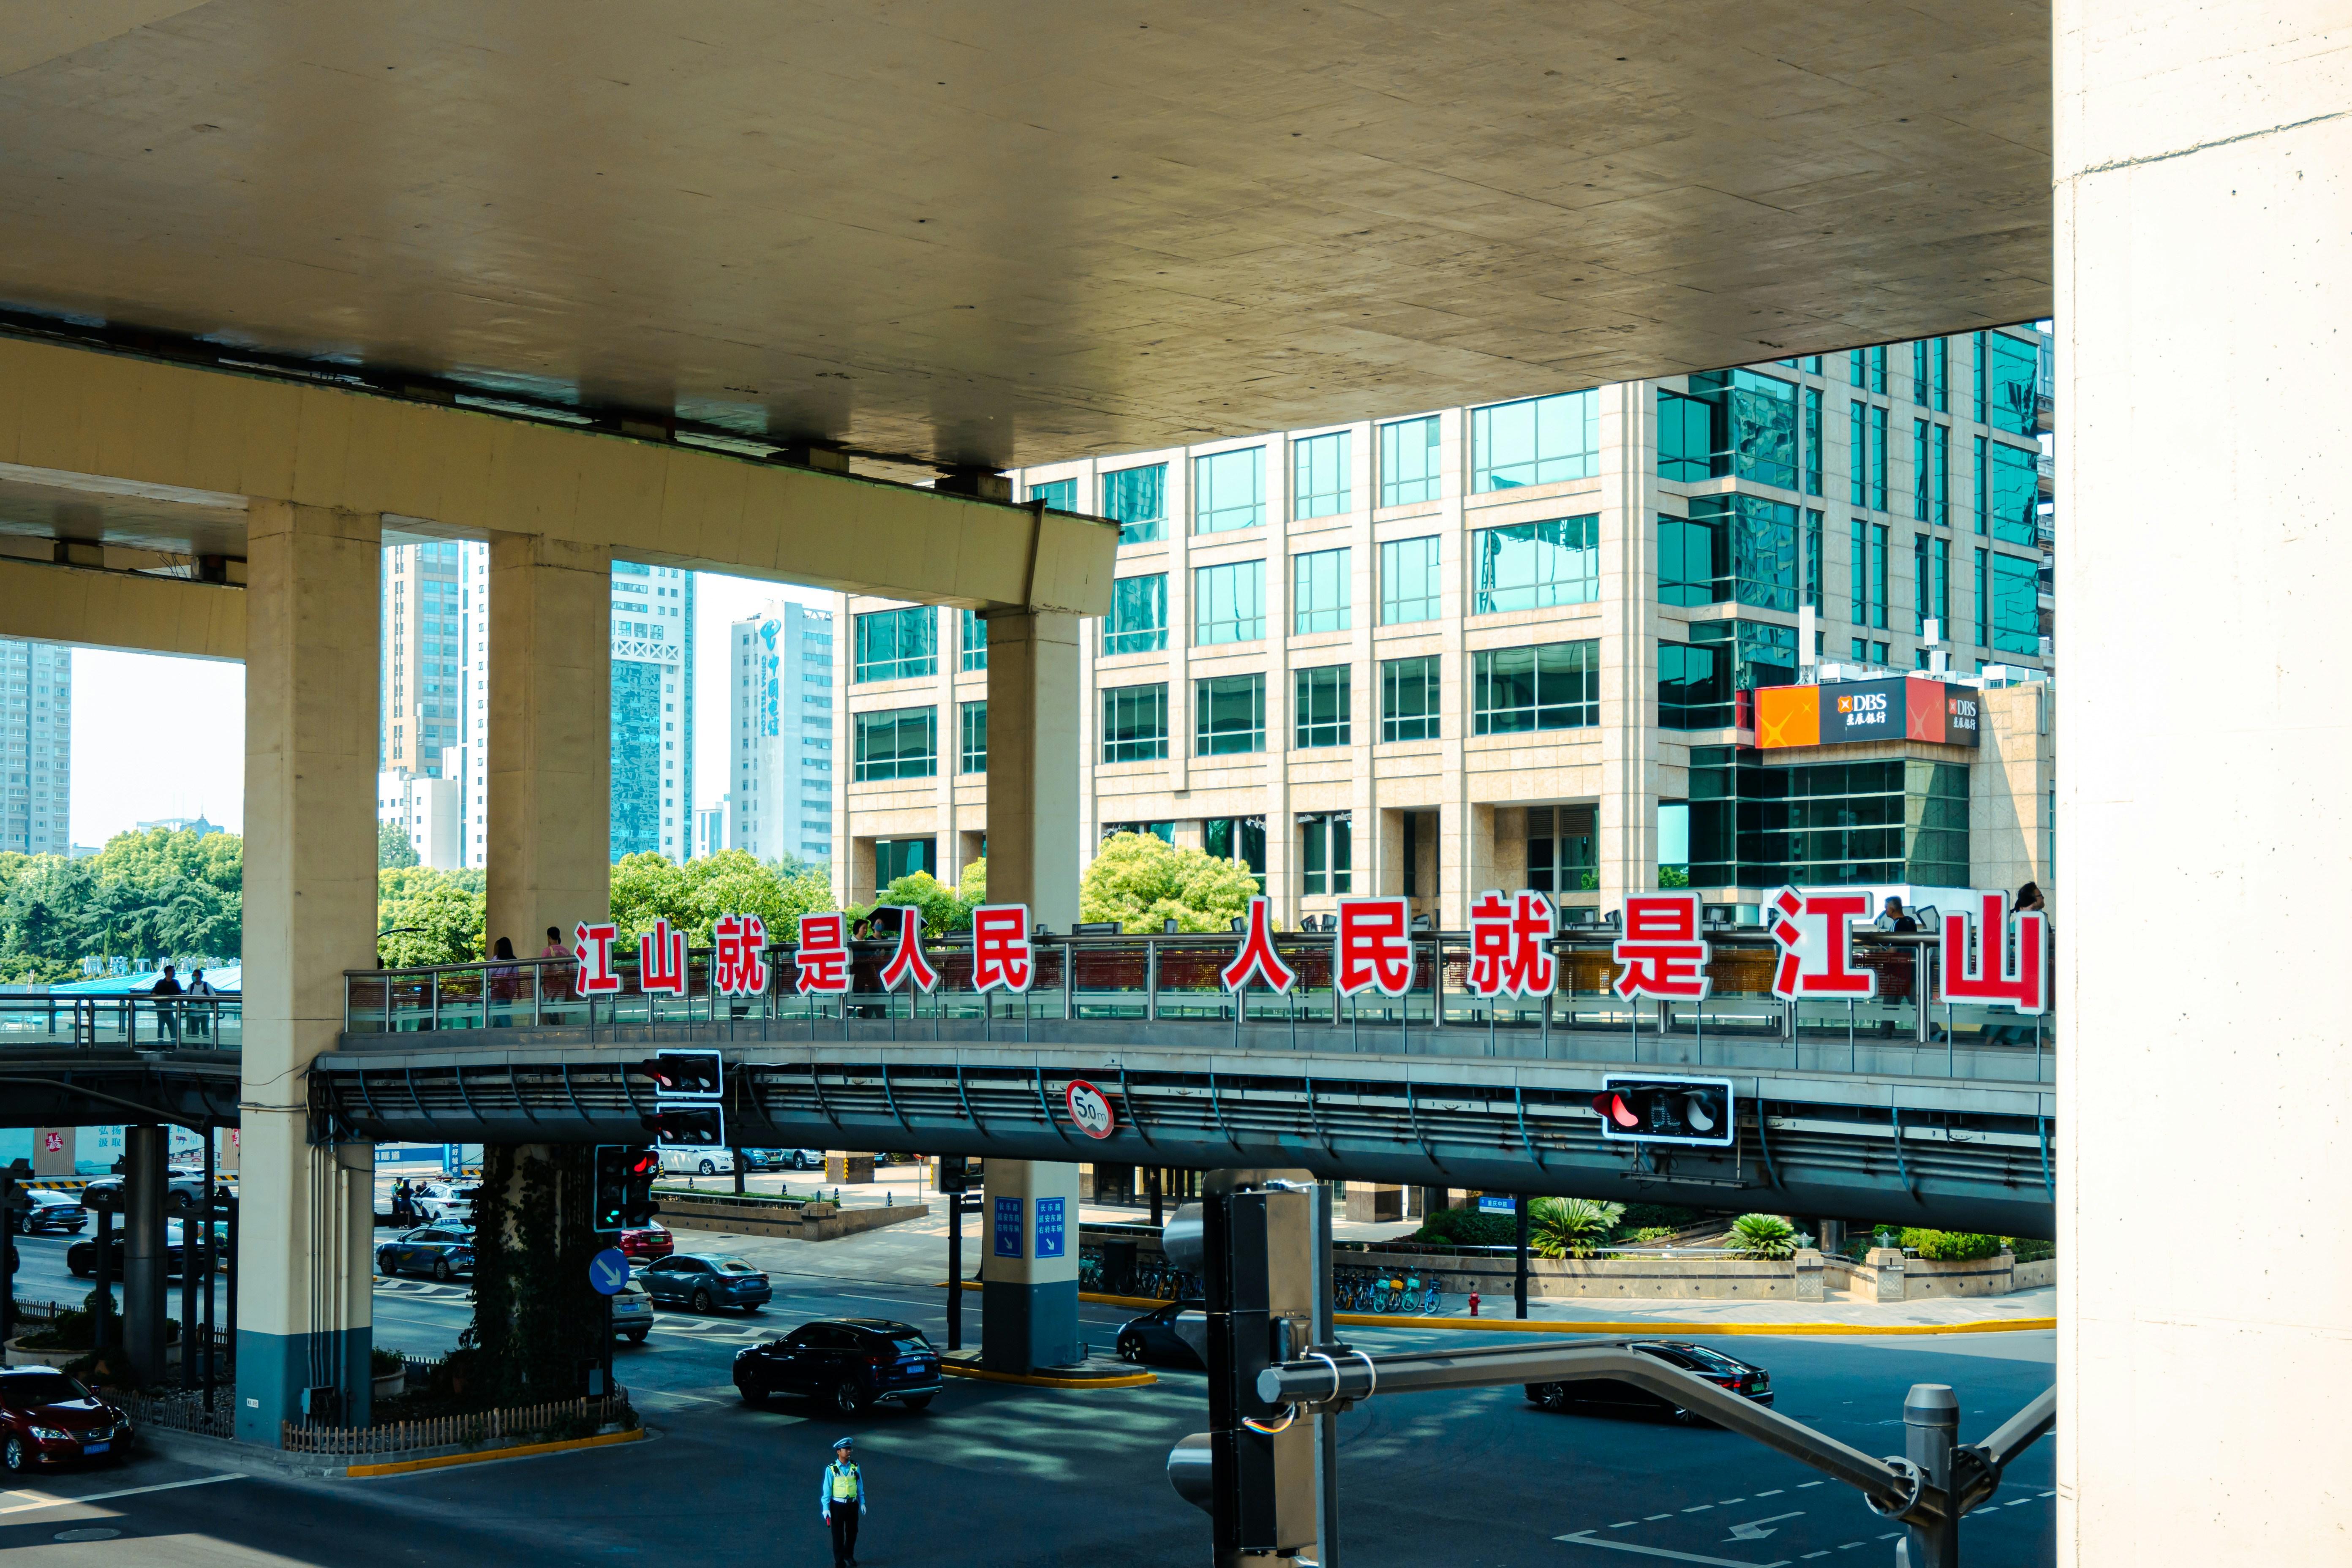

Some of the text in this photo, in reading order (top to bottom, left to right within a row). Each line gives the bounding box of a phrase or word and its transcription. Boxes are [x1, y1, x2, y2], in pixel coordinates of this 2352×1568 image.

[768, 653, 779, 736] 中国电信
[1854, 694, 1886, 711] DBS
[1957, 700, 1976, 716] DBS
[574, 885, 2048, 1015] 江山就是人民 人民就是江山
[999, 1203, 1018, 1211] 长乐路
[1040, 1203, 1060, 1212] 长乐路
[997, 1213, 1019, 1222] 延安东路
[1039, 1214, 1062, 1223] 延安东路
[997, 1224, 1019, 1233] 右转车辆
[1038, 1225, 1062, 1233] 右转车辆
